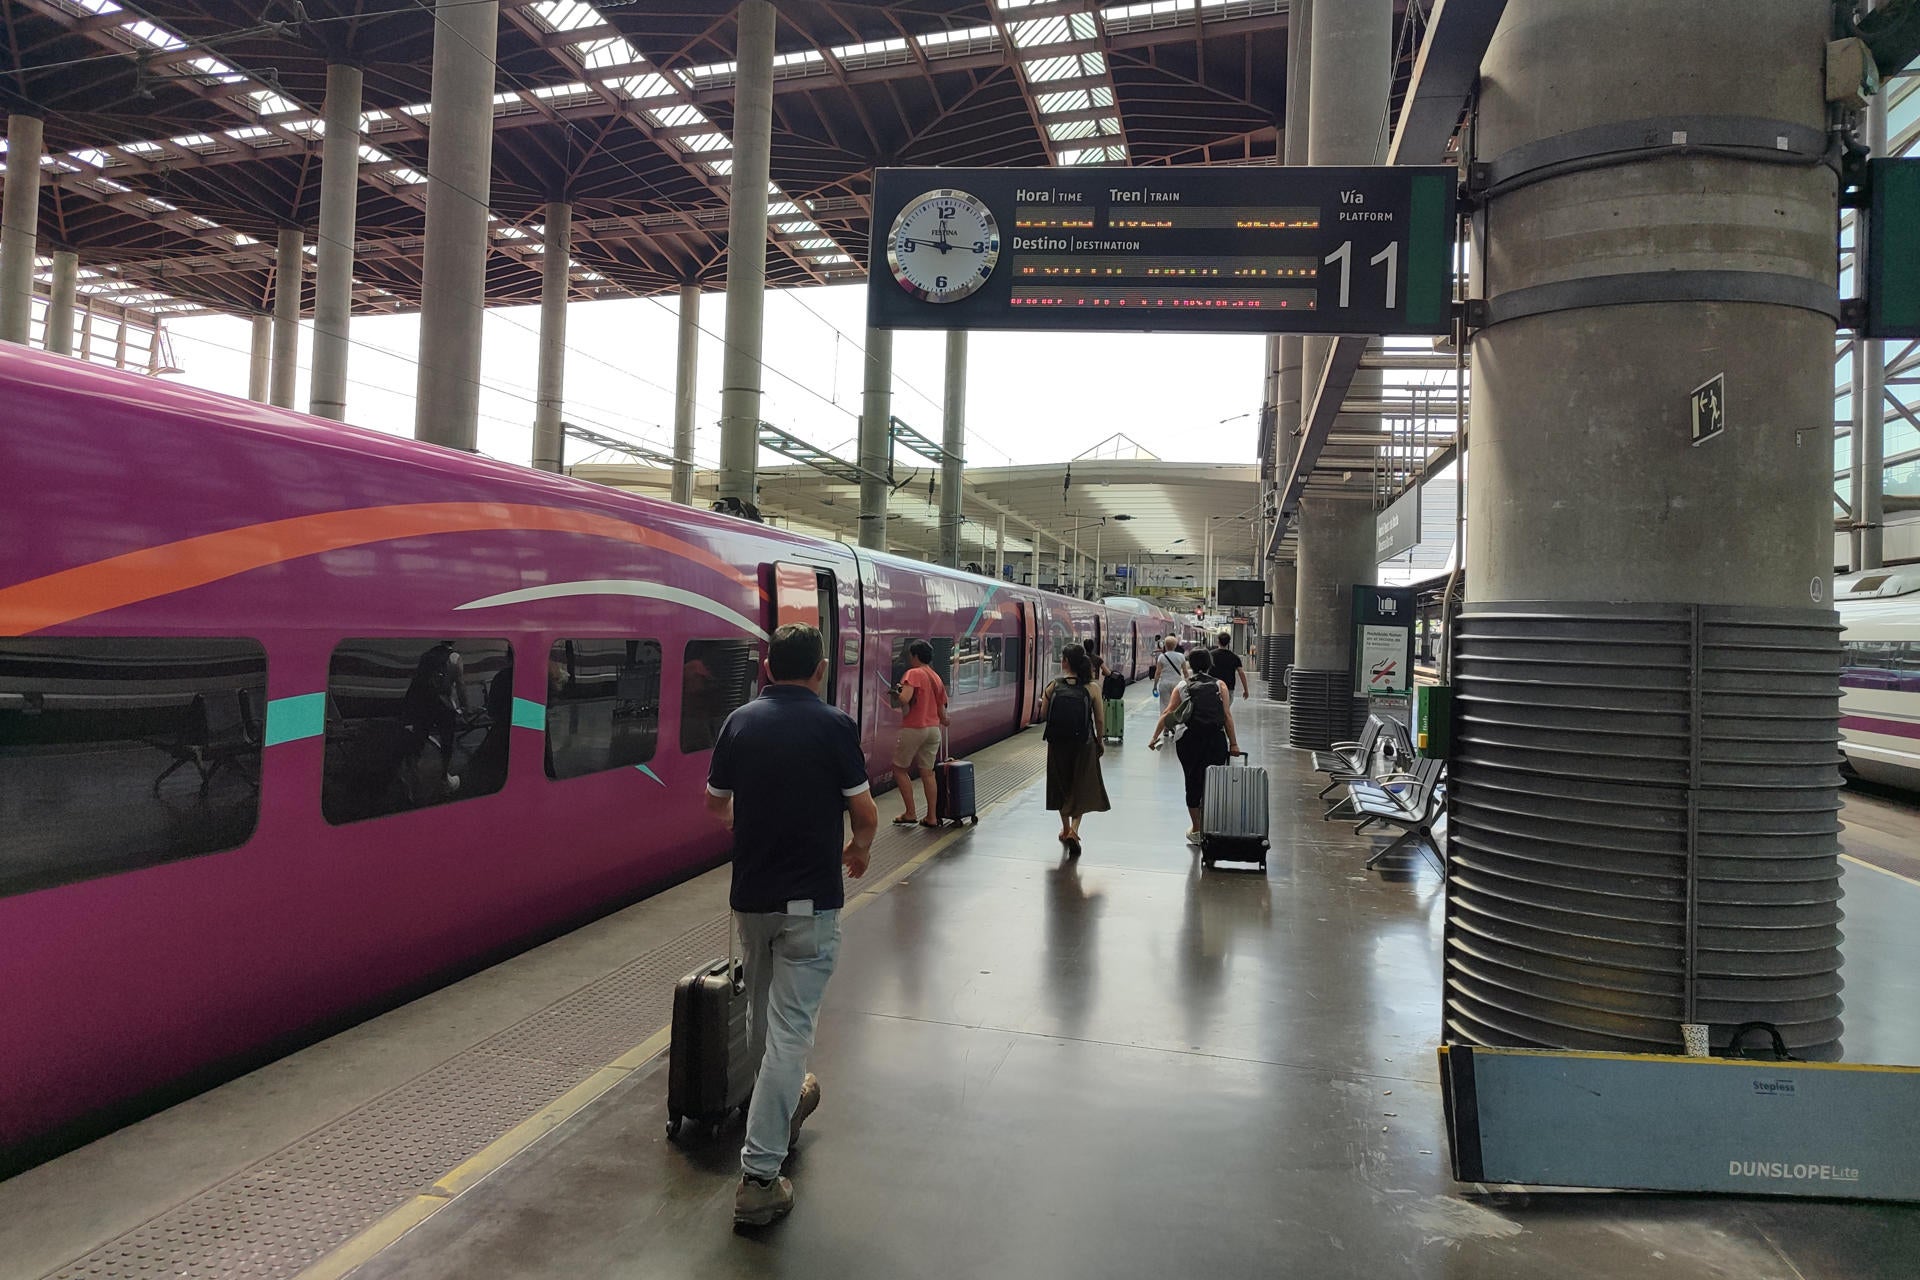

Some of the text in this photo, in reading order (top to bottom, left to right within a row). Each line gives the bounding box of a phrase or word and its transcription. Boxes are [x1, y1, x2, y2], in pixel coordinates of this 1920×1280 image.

[1016, 189, 1082, 201] Hora TIME
[1110, 189, 1180, 201] Tren TRAIN
[1340, 190, 1364, 204] Vía
[937, 206, 956, 219] 12
[1340, 212, 1393, 221] PLATFORM
[904, 239, 916, 253] 9
[973, 241, 985, 254] 3
[1013, 236, 1140, 250] Destino DESTINATION
[1324, 240, 1398, 309] 11
[936, 276, 948, 288] 6
